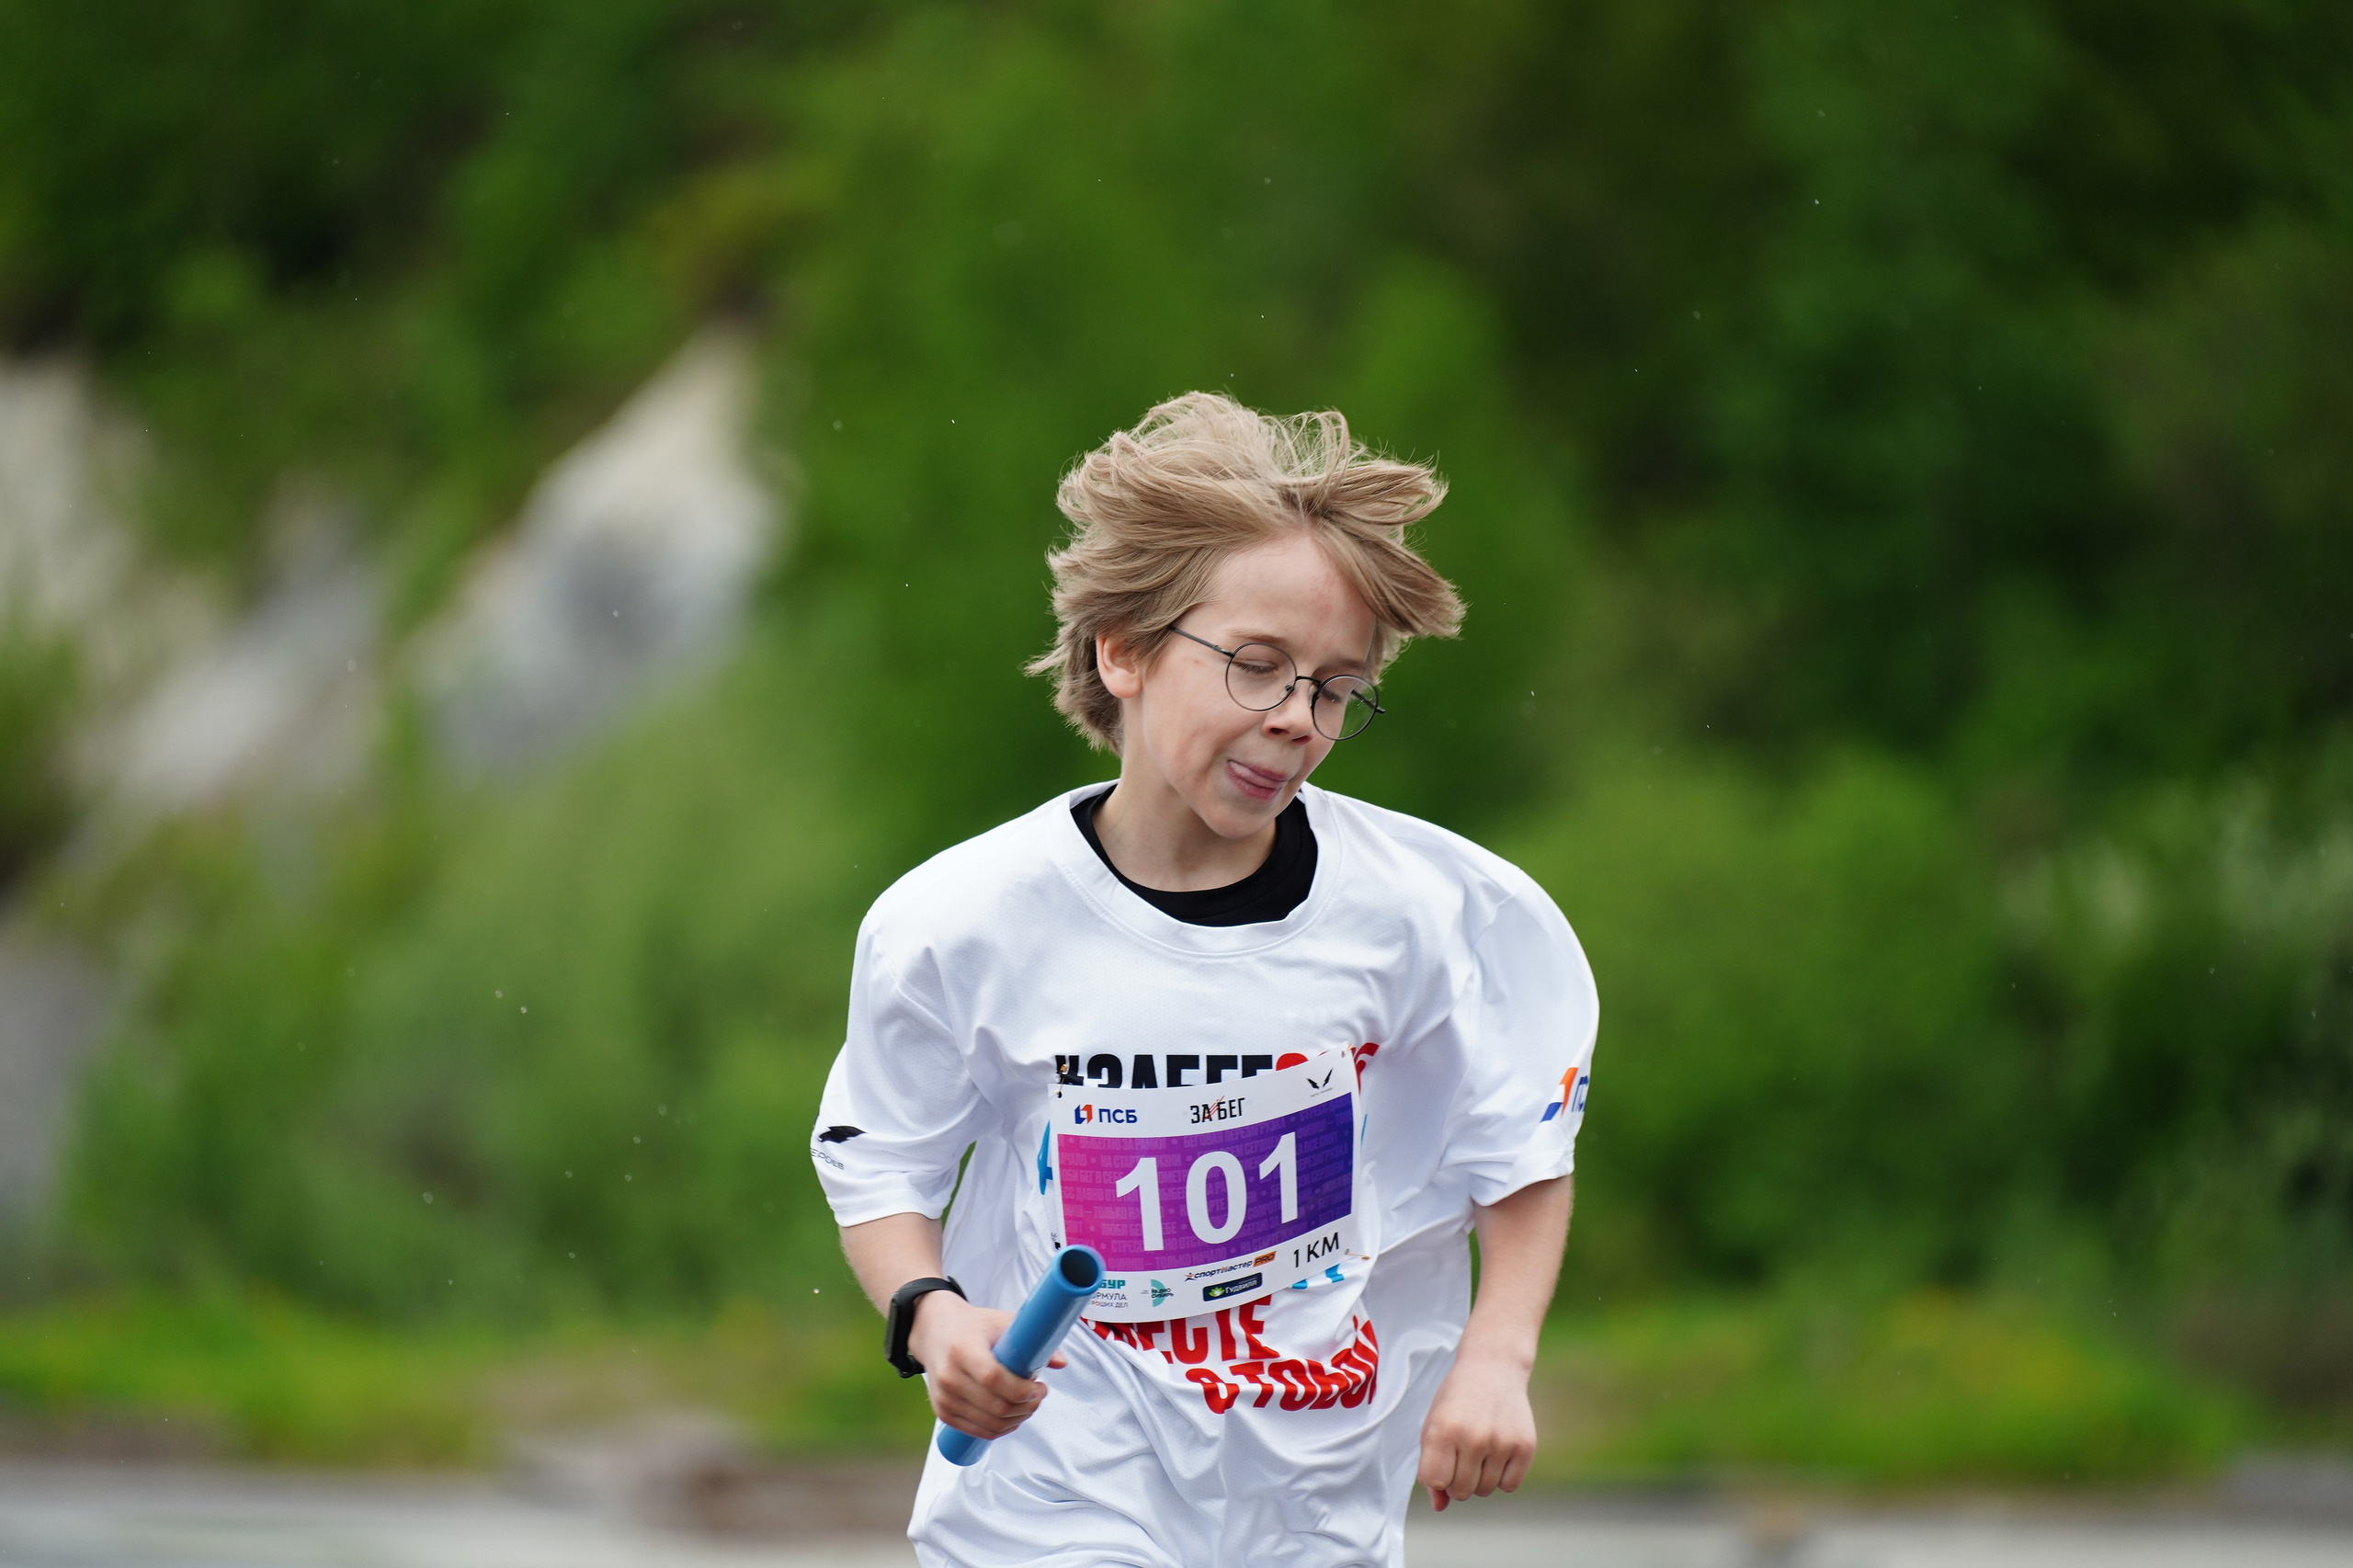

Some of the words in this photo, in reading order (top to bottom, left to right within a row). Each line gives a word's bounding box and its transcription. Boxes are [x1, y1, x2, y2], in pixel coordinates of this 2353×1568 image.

[1098, 1108, 1138, 1123] ПСБ
[1115, 1131, 1299, 1252] 101
[1255, 1254, 1276, 1267] PRO
[1293, 1249, 1300, 1268] 1
[1100, 1278, 1126, 1290] БУР
